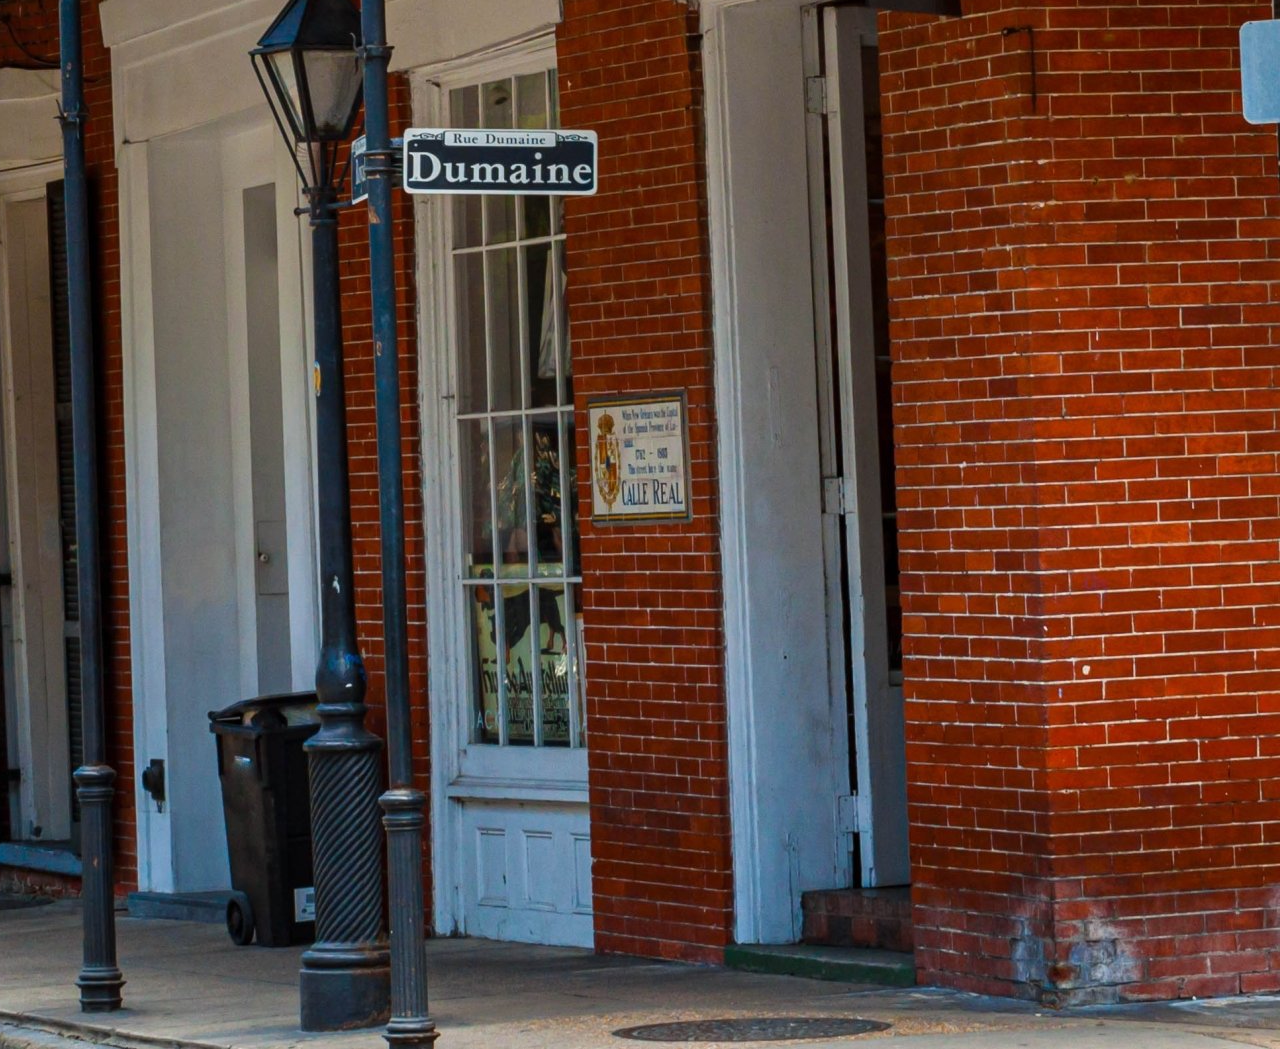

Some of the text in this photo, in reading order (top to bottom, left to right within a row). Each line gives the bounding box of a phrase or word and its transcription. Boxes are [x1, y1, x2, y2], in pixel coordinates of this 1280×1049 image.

[453, 133, 546, 145] Rue Dumaine
[408, 151, 592, 185] Dumaine
[622, 478, 683, 506] CALLE REAL
